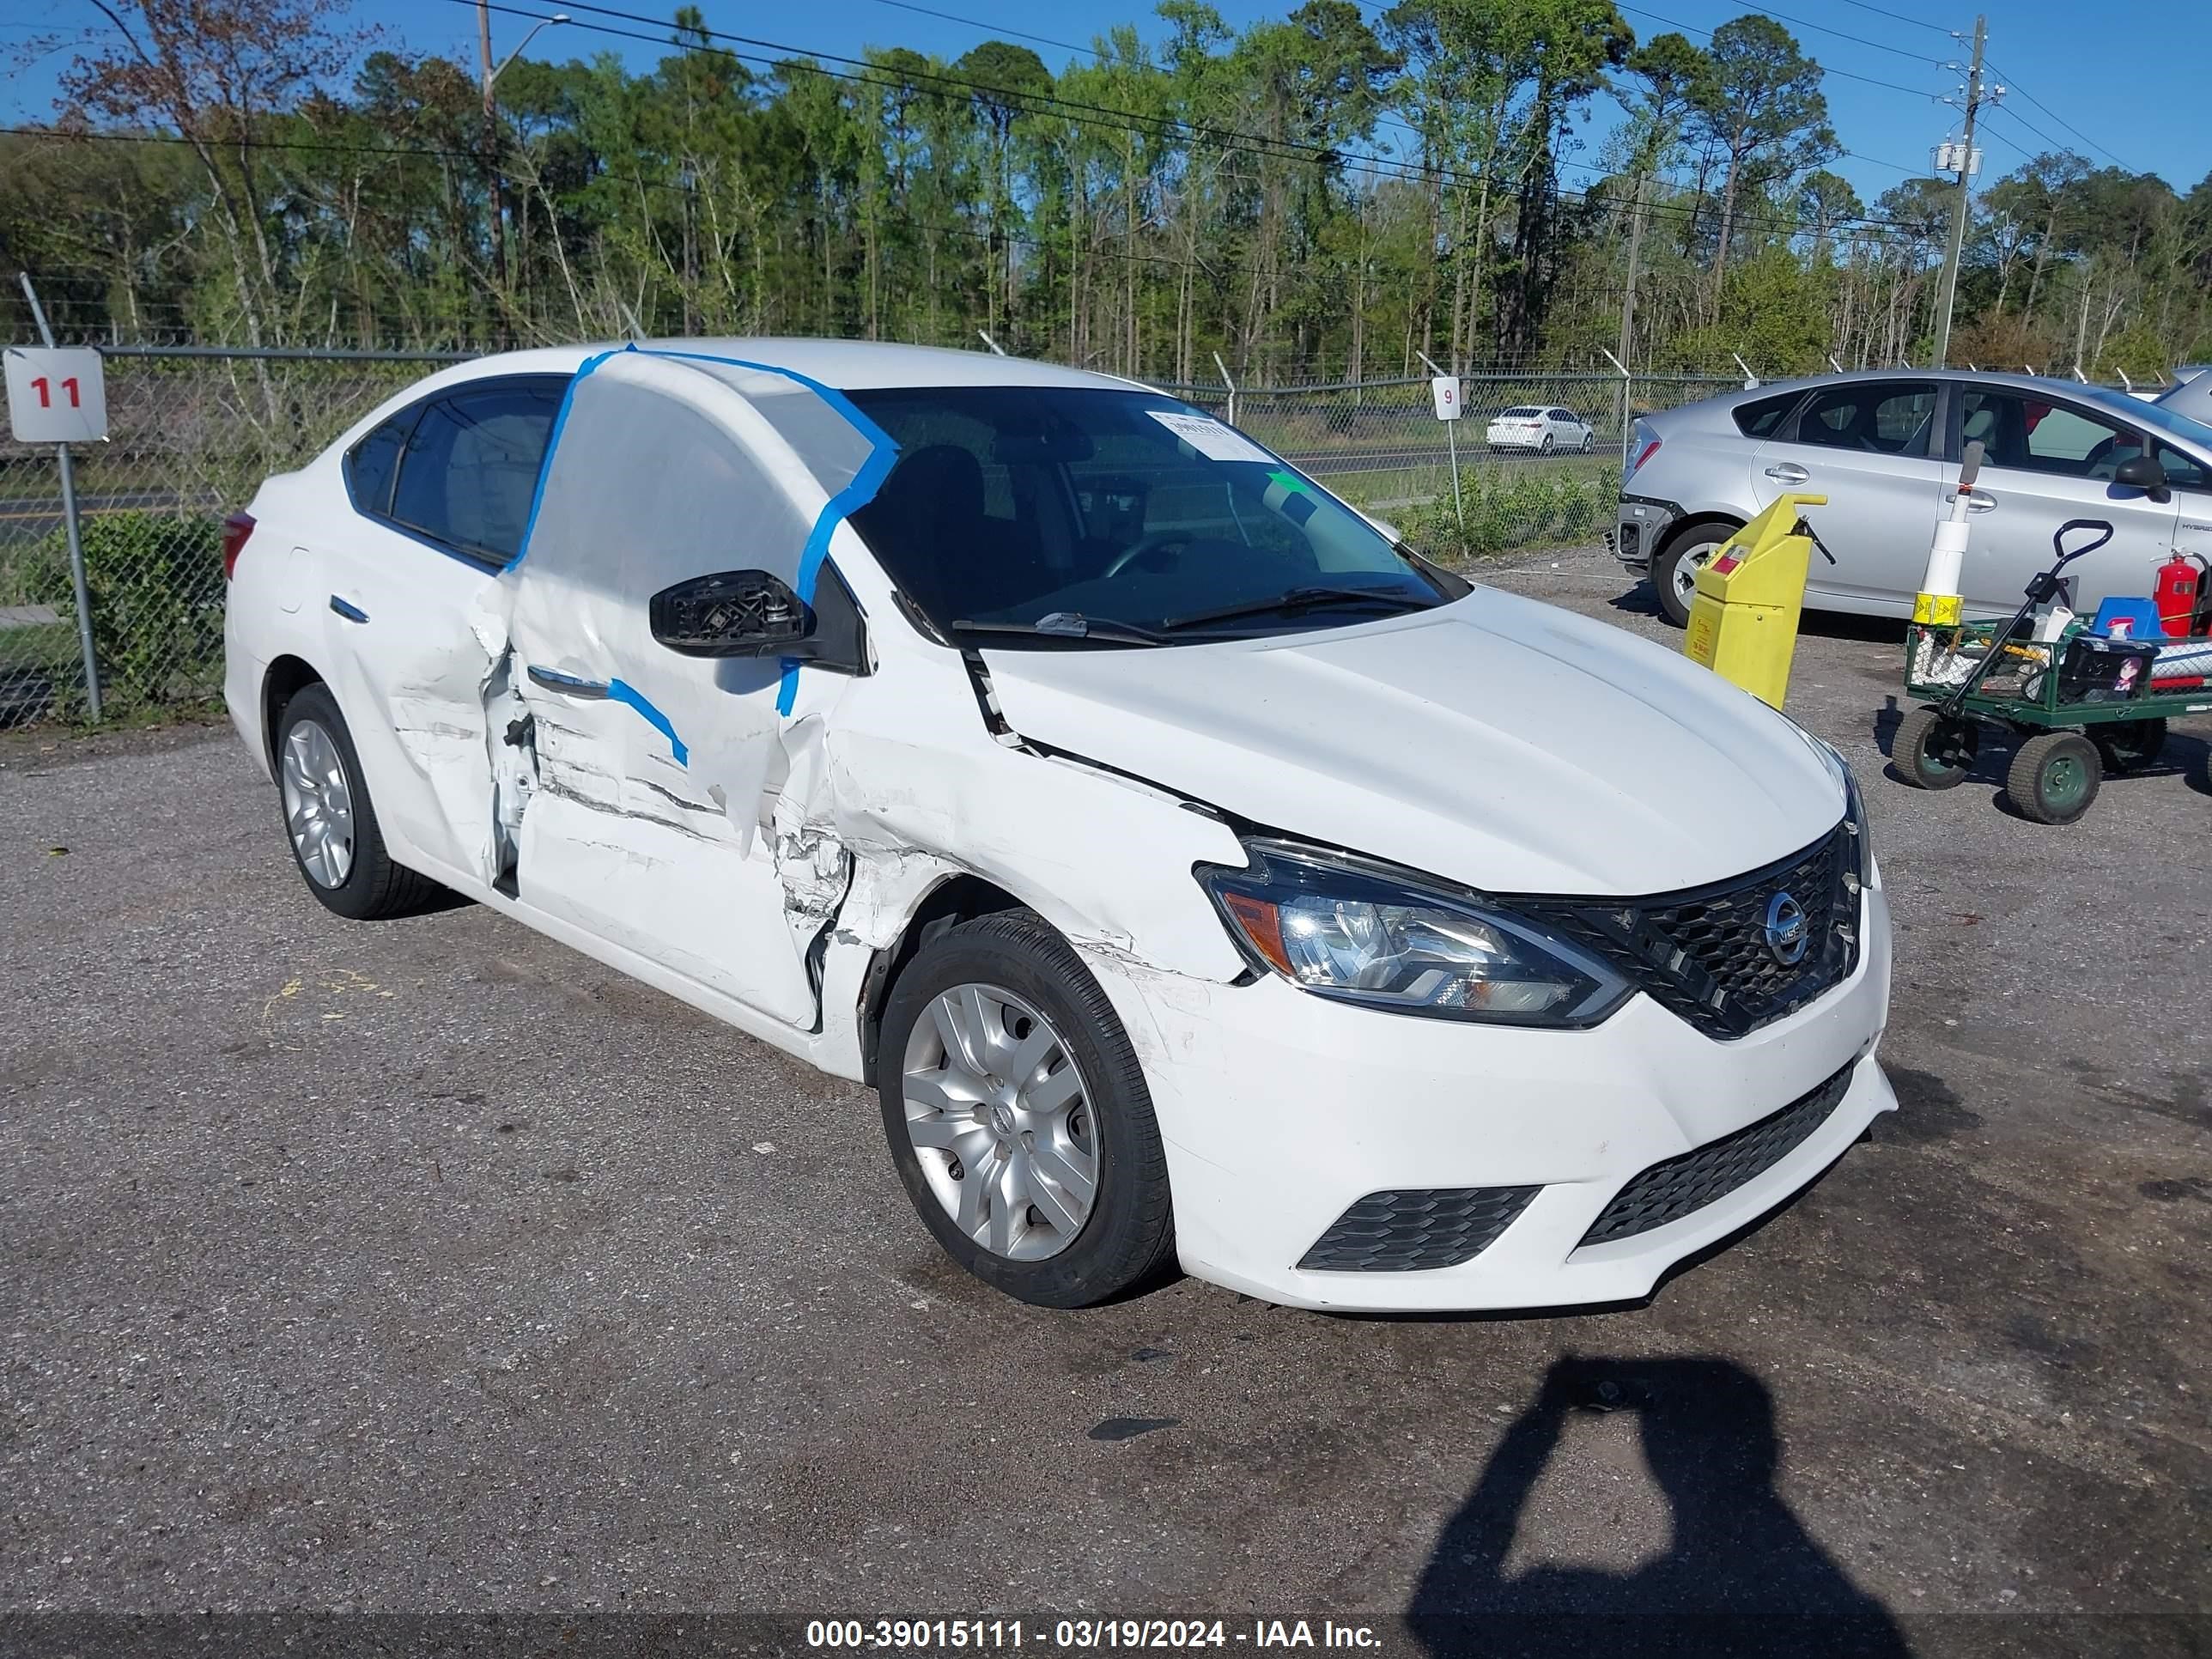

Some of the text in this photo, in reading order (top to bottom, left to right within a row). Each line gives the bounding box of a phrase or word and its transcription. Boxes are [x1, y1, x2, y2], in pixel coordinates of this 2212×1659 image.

[31, 376, 81, 408] 11
[1443, 389, 1453, 404] 9
[1778, 921, 1806, 942] NISS
